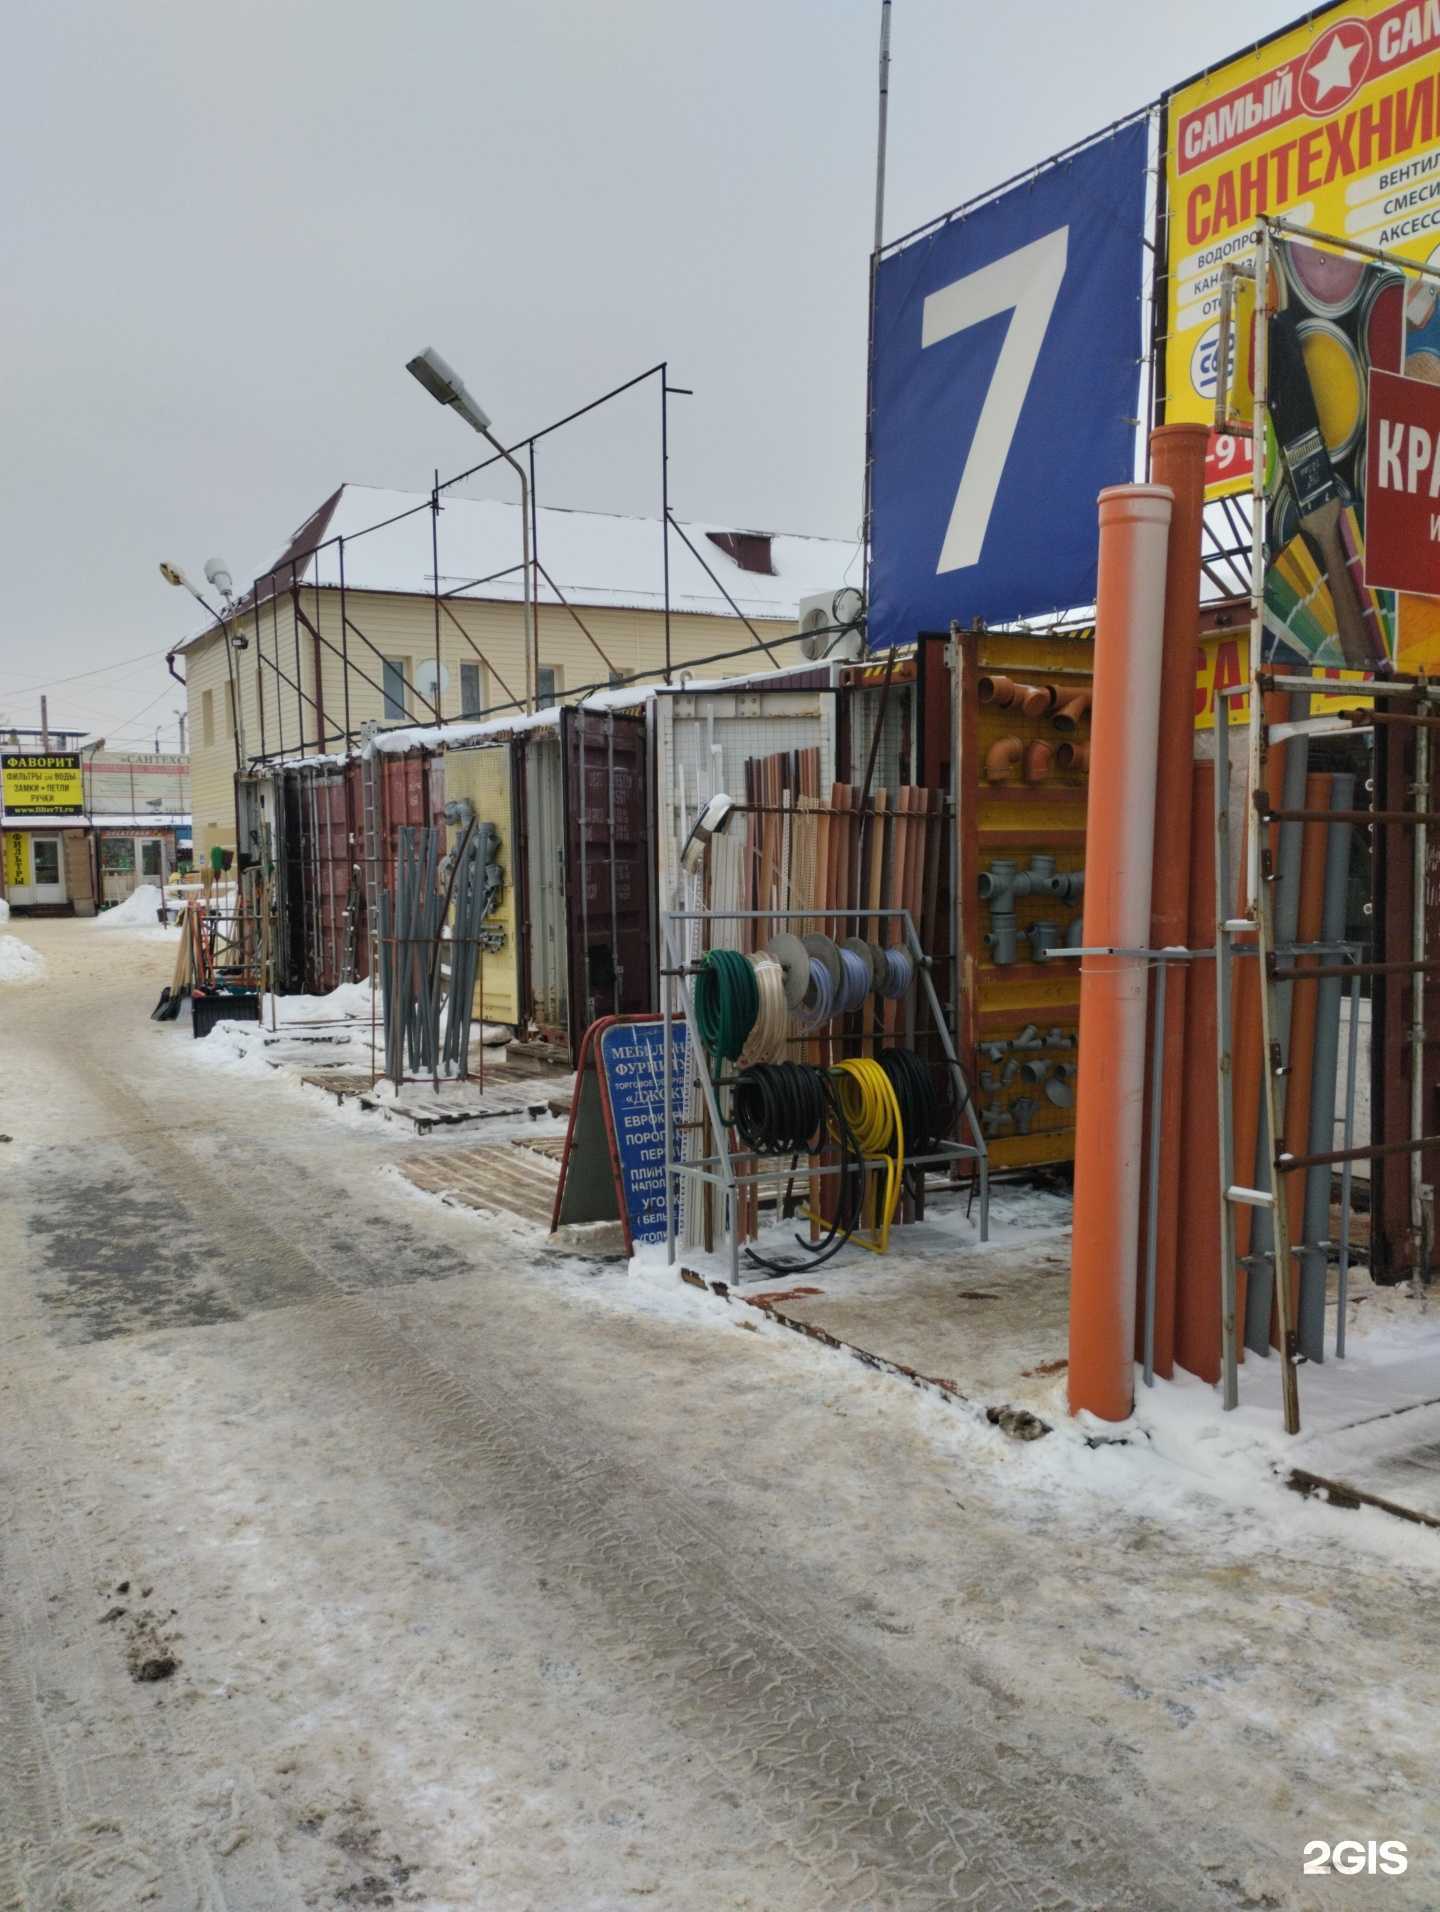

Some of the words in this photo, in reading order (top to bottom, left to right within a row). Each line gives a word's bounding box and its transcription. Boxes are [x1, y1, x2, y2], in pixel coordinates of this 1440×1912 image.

[1184, 65, 1293, 160] САМЫЙ
[1186, 72, 1440, 247] САНТЕХНИ
[921, 225, 1070, 575] 7
[7, 757, 75, 768] ФАВОРИТ
[7, 772, 42, 780] ФИЛЬТРЫ
[14, 784, 39, 792] ЗАМКИ
[47, 784, 70, 792] ПЕТЛИ
[30, 794, 55, 802] РУЧКИ
[13, 833, 24, 885] ФИЛЬТРЫ
